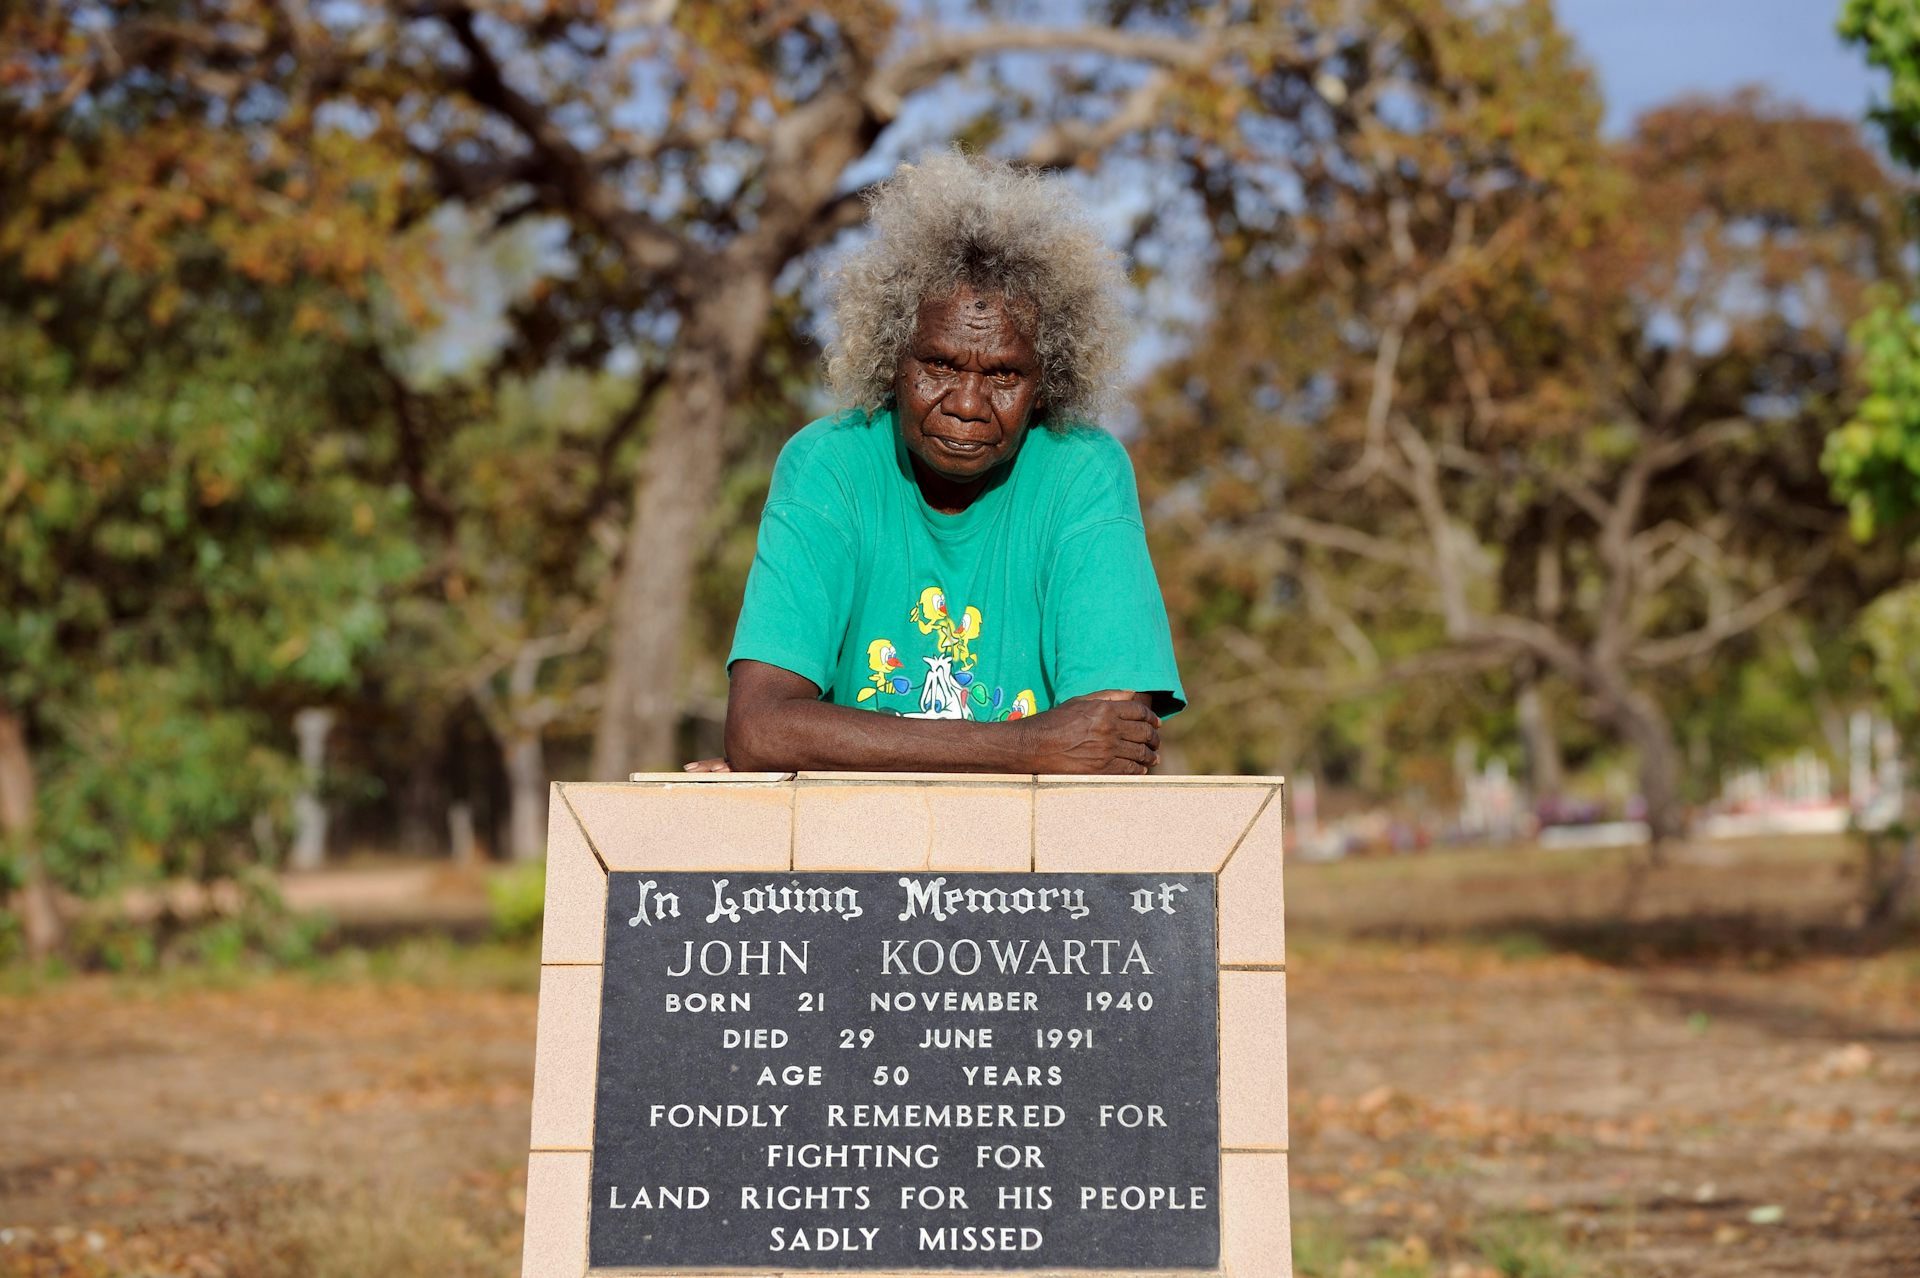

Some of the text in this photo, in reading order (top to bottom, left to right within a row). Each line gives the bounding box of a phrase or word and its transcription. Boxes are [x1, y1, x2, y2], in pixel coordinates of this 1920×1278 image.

[629, 877, 1188, 927] In Loving Memory of
[667, 939, 1155, 976] JOHN KOOWARTA
[665, 992, 1154, 1013] BORN 21 NOVEMBER 1940
[723, 1029, 1093, 1049] DIED 29 JUNE 1991
[757, 1066, 1063, 1086] AGE 50 YEARS
[650, 1104, 1168, 1127] FONDLY REMEMBERED FOR
[767, 1144, 1046, 1169] FIGHTING FOR
[610, 1186, 1207, 1210] LAND RIGHTS FOR HIS PEOPLE
[769, 1227, 1043, 1251] SADLY MISSED
